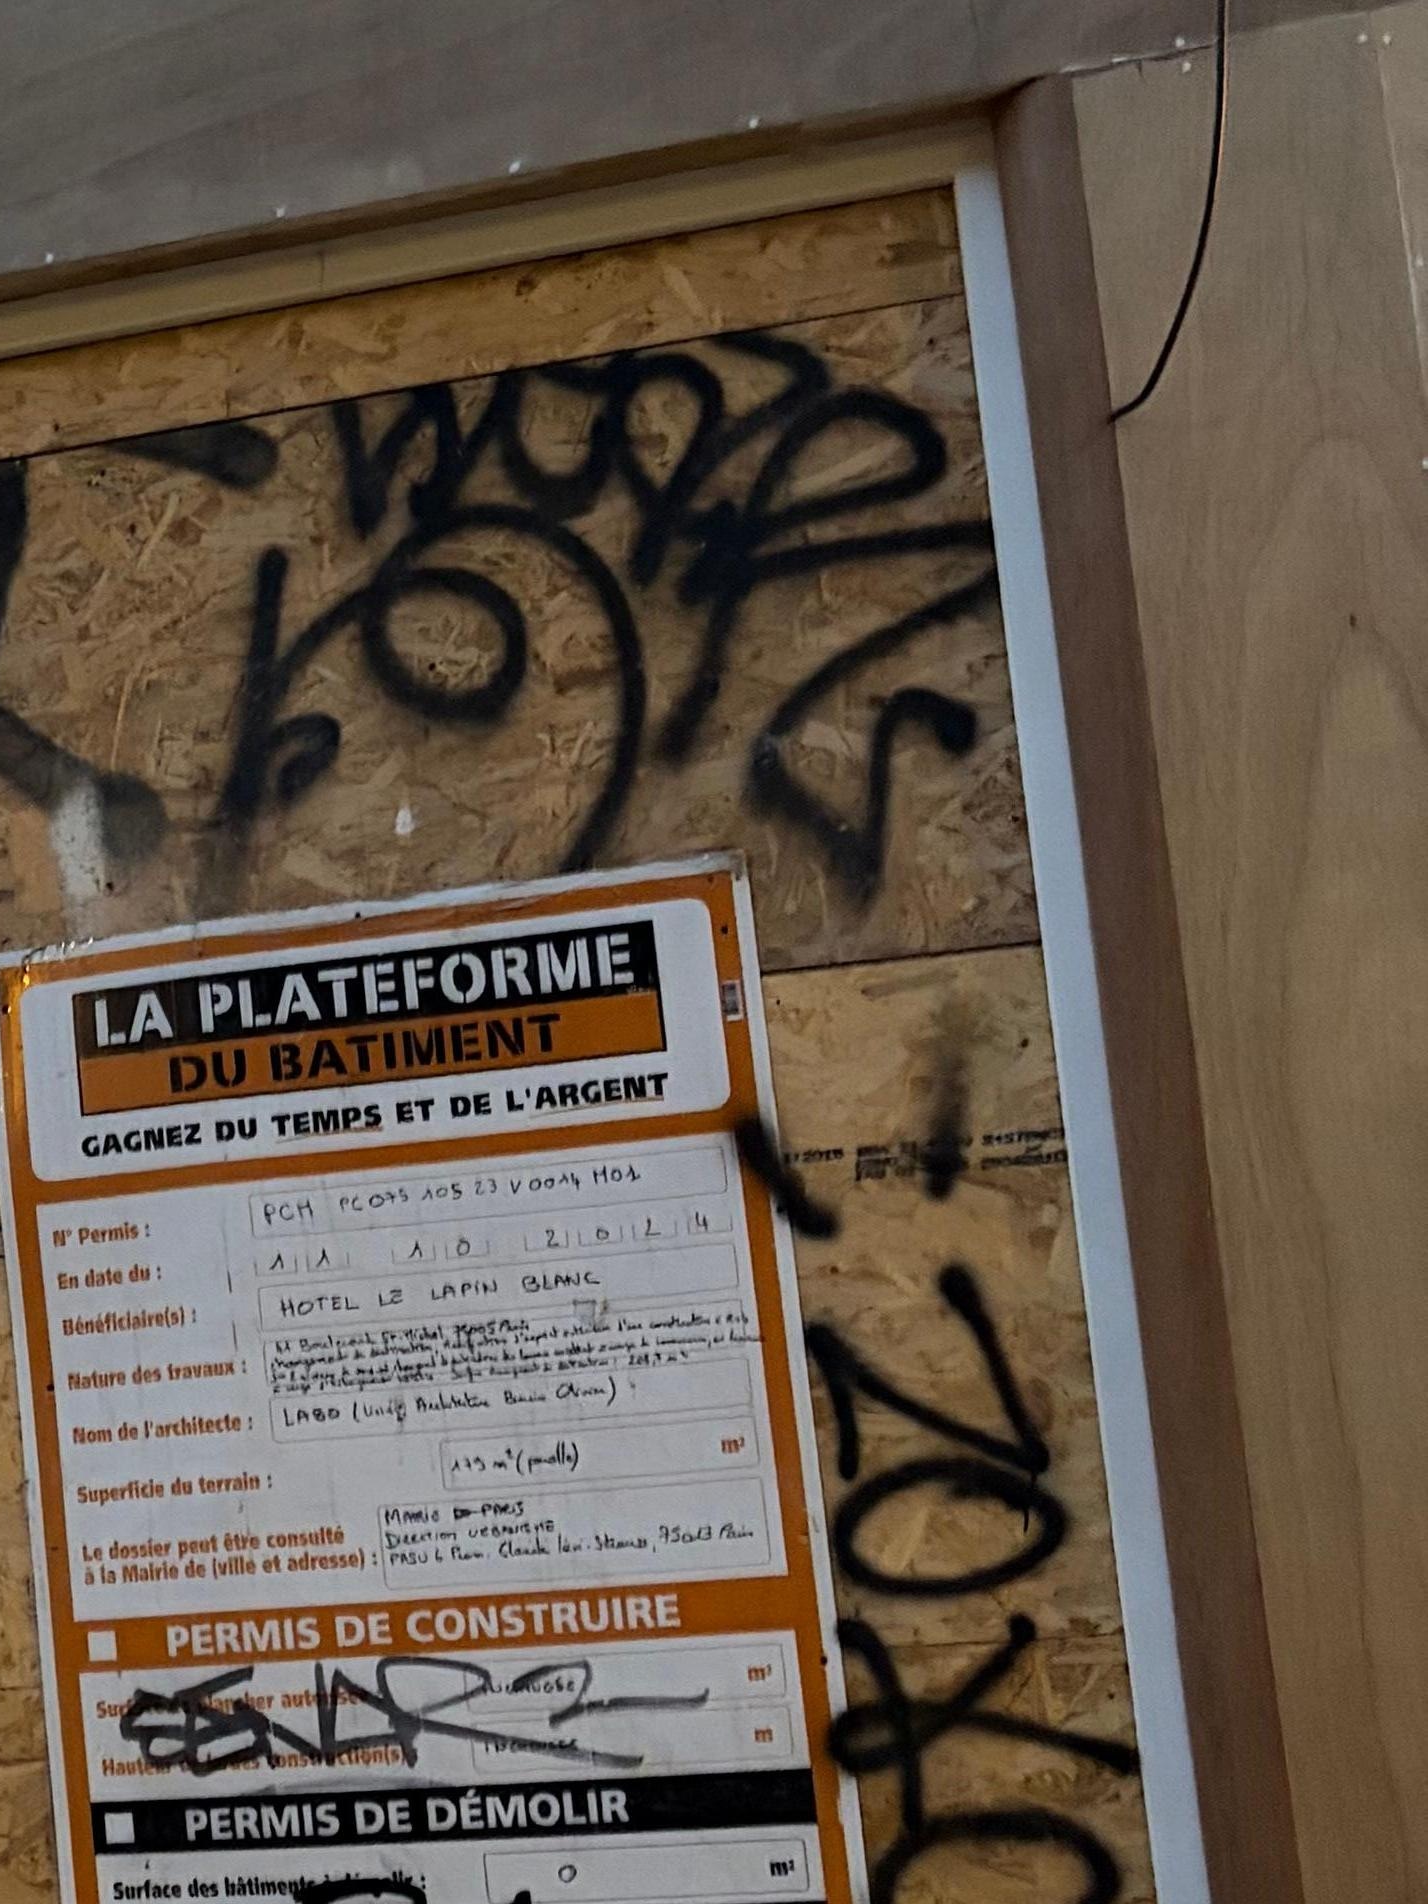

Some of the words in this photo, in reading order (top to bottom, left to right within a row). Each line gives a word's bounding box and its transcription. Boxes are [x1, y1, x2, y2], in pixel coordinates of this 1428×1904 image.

[93, 991, 174, 1050] LA
[199, 932, 636, 1034] PLATEFORME
[169, 1050, 248, 1095] DU
[270, 1013, 561, 1083] BATIMENT
[80, 1122, 203, 1158] GAGNEZ
[214, 1118, 259, 1142] DU
[271, 1104, 383, 1137] TEMPS
[396, 1098, 434, 1124] ET
[450, 1093, 493, 1119] DE
[504, 1073, 669, 1111] L'ARGENT
[52, 1227, 74, 1247] N°
[78, 1221, 140, 1246] Permis
[57, 1271, 79, 1290] En
[84, 1265, 124, 1288] date
[128, 1263, 152, 1284] du
[280, 1294, 360, 1318] HOTEL
[521, 1270, 602, 1295] BLANC
[61, 1306, 186, 1337] Bénéficiaire(s)
[67, 1366, 127, 1392] Nature
[131, 1364, 163, 1386] des
[166, 1358, 236, 1383] travaux
[72, 1425, 114, 1447] Nom
[117, 1420, 139, 1441] de
[144, 1413, 243, 1440] l'architecte
[76, 1478, 166, 1507] Superficie
[170, 1475, 194, 1496] du
[197, 1471, 262, 1495] terrain
[82, 1543, 104, 1562] Le
[108, 1538, 172, 1560] dossier
[177, 1534, 219, 1559] peut
[222, 1531, 261, 1552] être
[265, 1525, 345, 1548] consulté
[84, 1566, 95, 1586] à
[100, 1564, 117, 1585] la
[121, 1560, 180, 1583] Mairie
[183, 1557, 206, 1578] de
[212, 1555, 256, 1580] (ville
[261, 1554, 282, 1574] et
[286, 1547, 366, 1573] adresse)
[166, 1615, 322, 1658] PERMIS
[334, 1610, 392, 1648] DE
[405, 1594, 683, 1643] CONSTRUIRE
[753, 1724, 775, 1744] m
[186, 1803, 341, 1843] PERMIS
[354, 1799, 414, 1836] DE
[426, 1786, 630, 1832] DÉMOLIR
[112, 1879, 182, 1901] Surface
[187, 1877, 219, 1899] des
